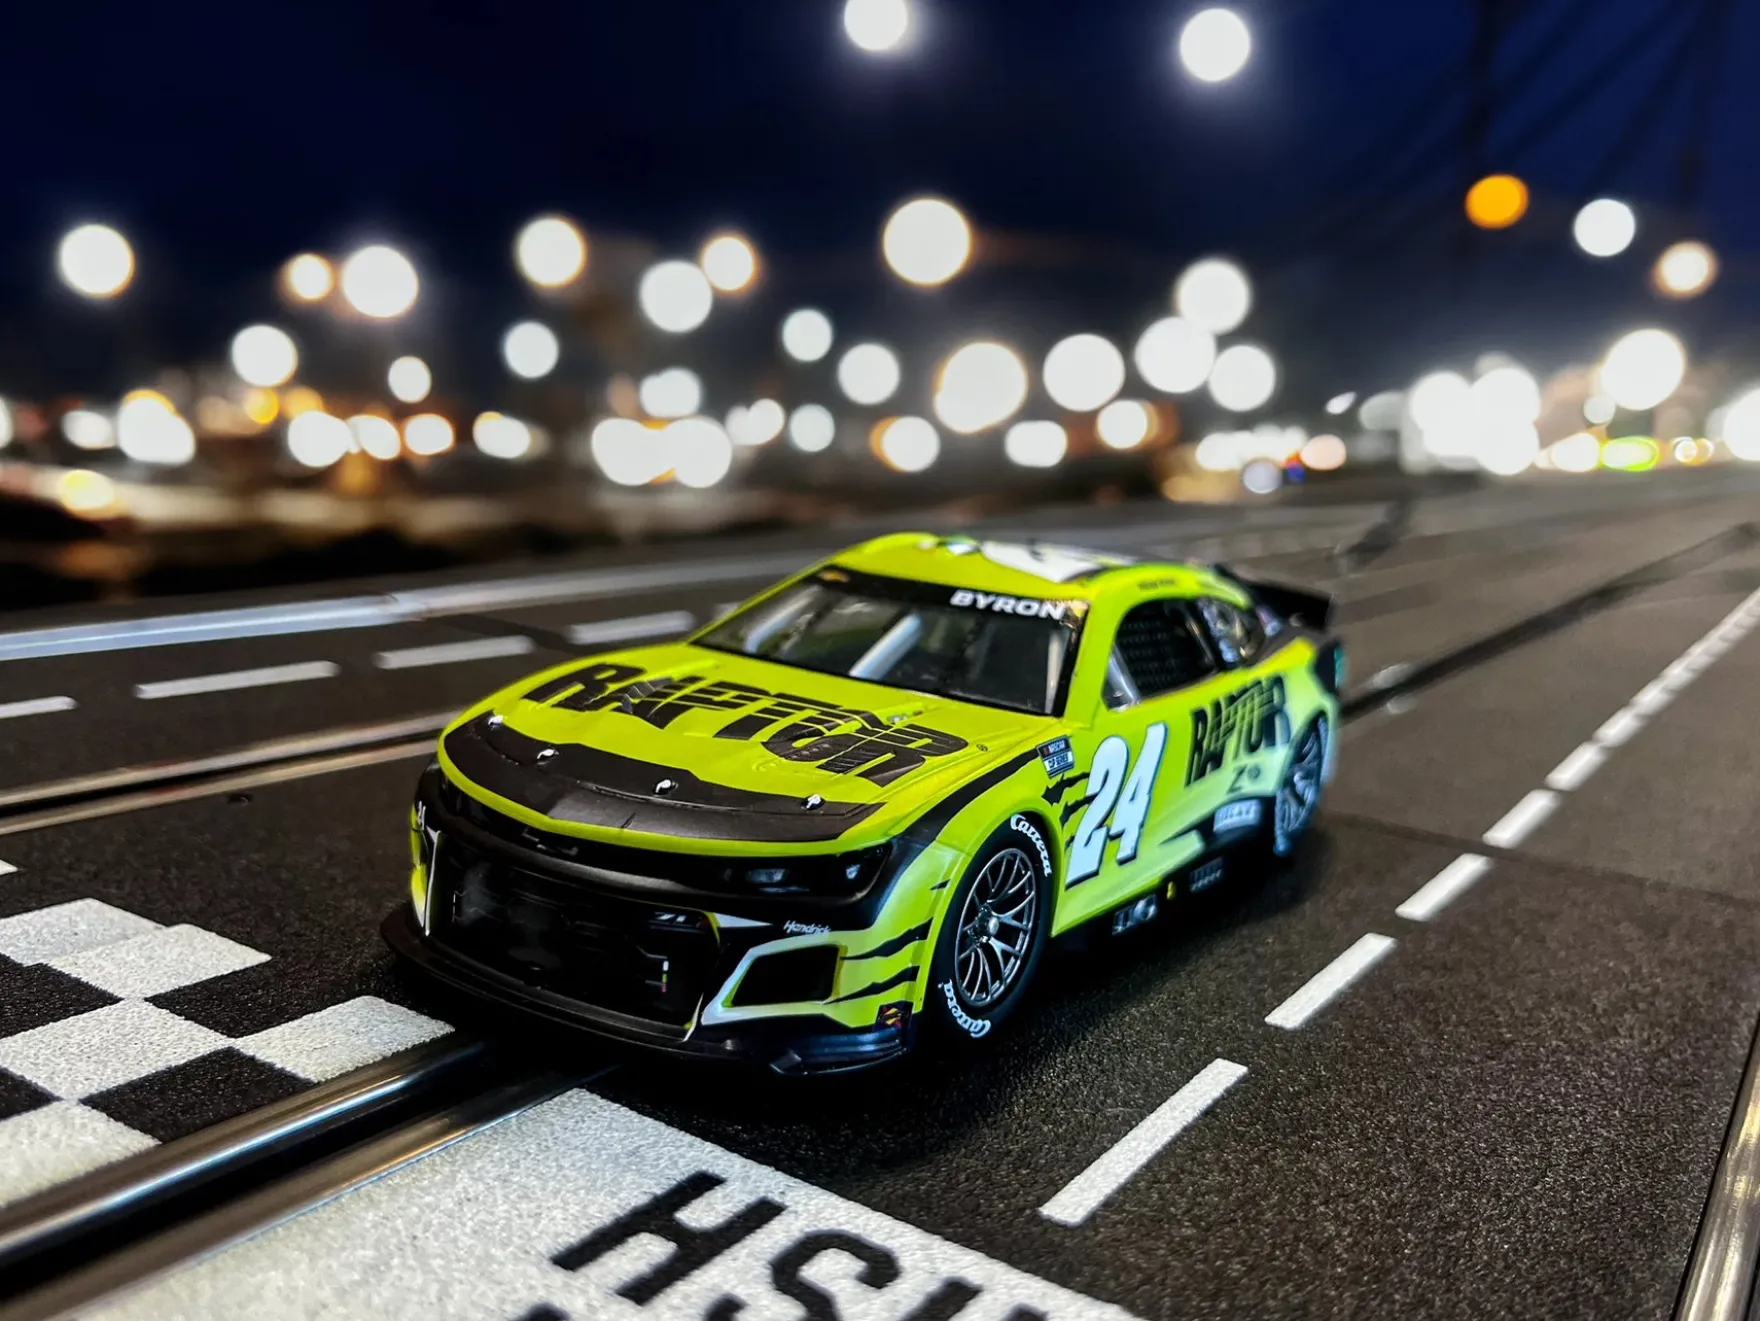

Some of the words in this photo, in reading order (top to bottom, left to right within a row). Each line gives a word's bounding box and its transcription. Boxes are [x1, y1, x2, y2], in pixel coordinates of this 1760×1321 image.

[950, 589, 1066, 620] BYRON
[520, 663, 968, 788] RAPTOR
[1183, 674, 1291, 788] RAPTOR
[1065, 721, 1168, 889] 24
[1010, 813, 1052, 877] Carrera
[783, 920, 831, 936] Hendrick
[938, 978, 991, 1038] Carrera
